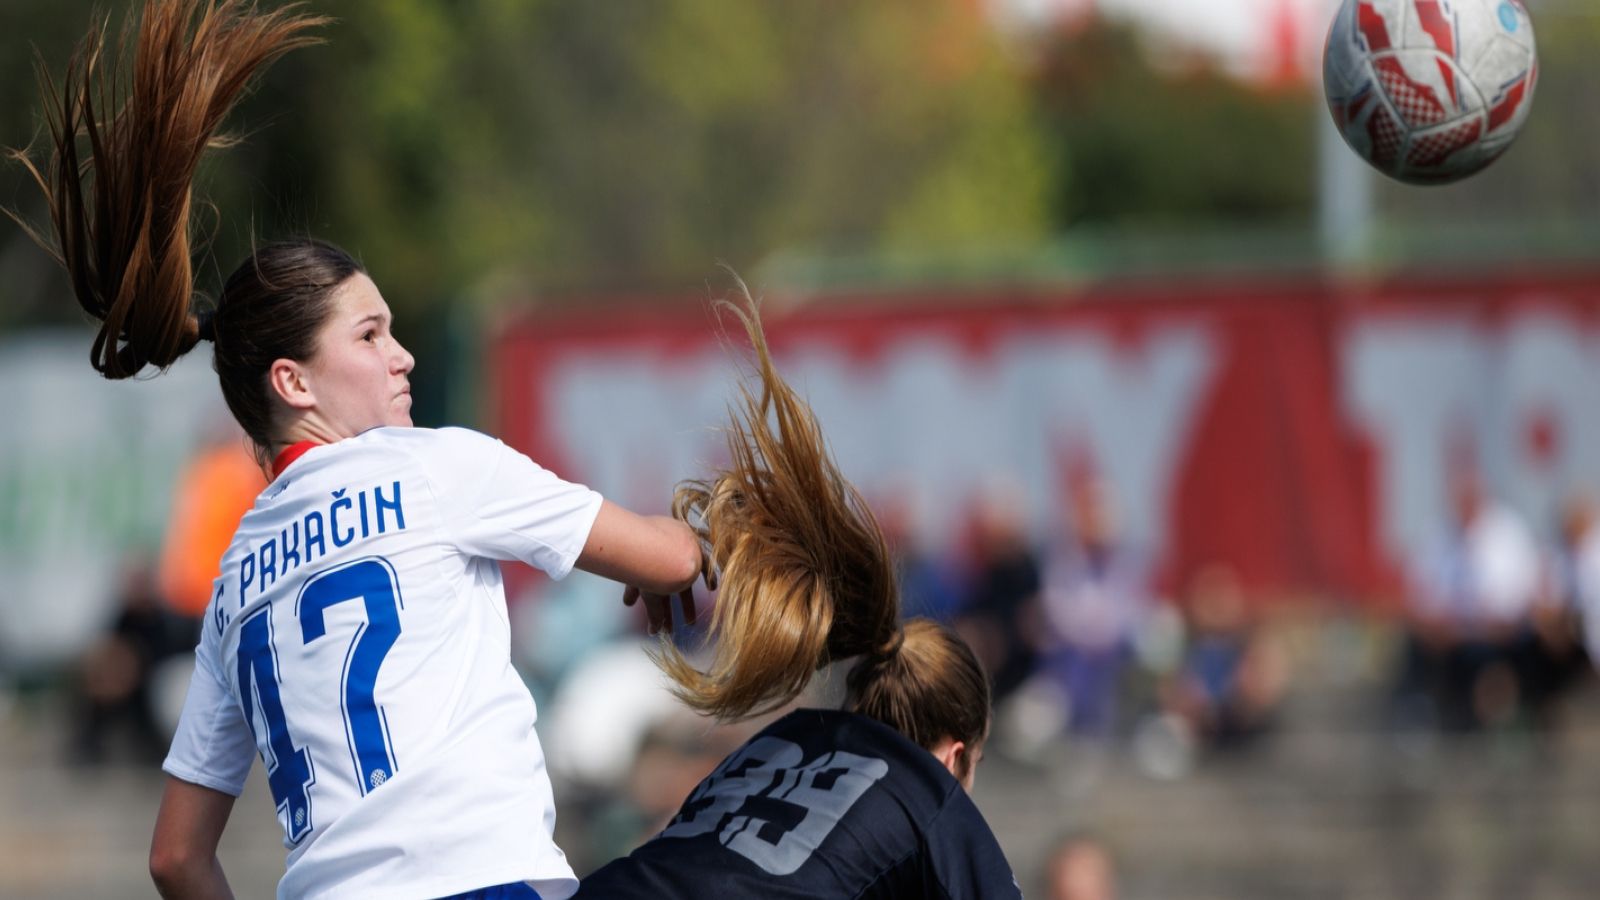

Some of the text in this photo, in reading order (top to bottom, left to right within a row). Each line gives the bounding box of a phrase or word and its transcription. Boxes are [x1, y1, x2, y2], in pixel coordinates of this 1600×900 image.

[214, 583, 231, 637] G.
[240, 480, 406, 609] PRKAČIN
[236, 555, 405, 845] 47
